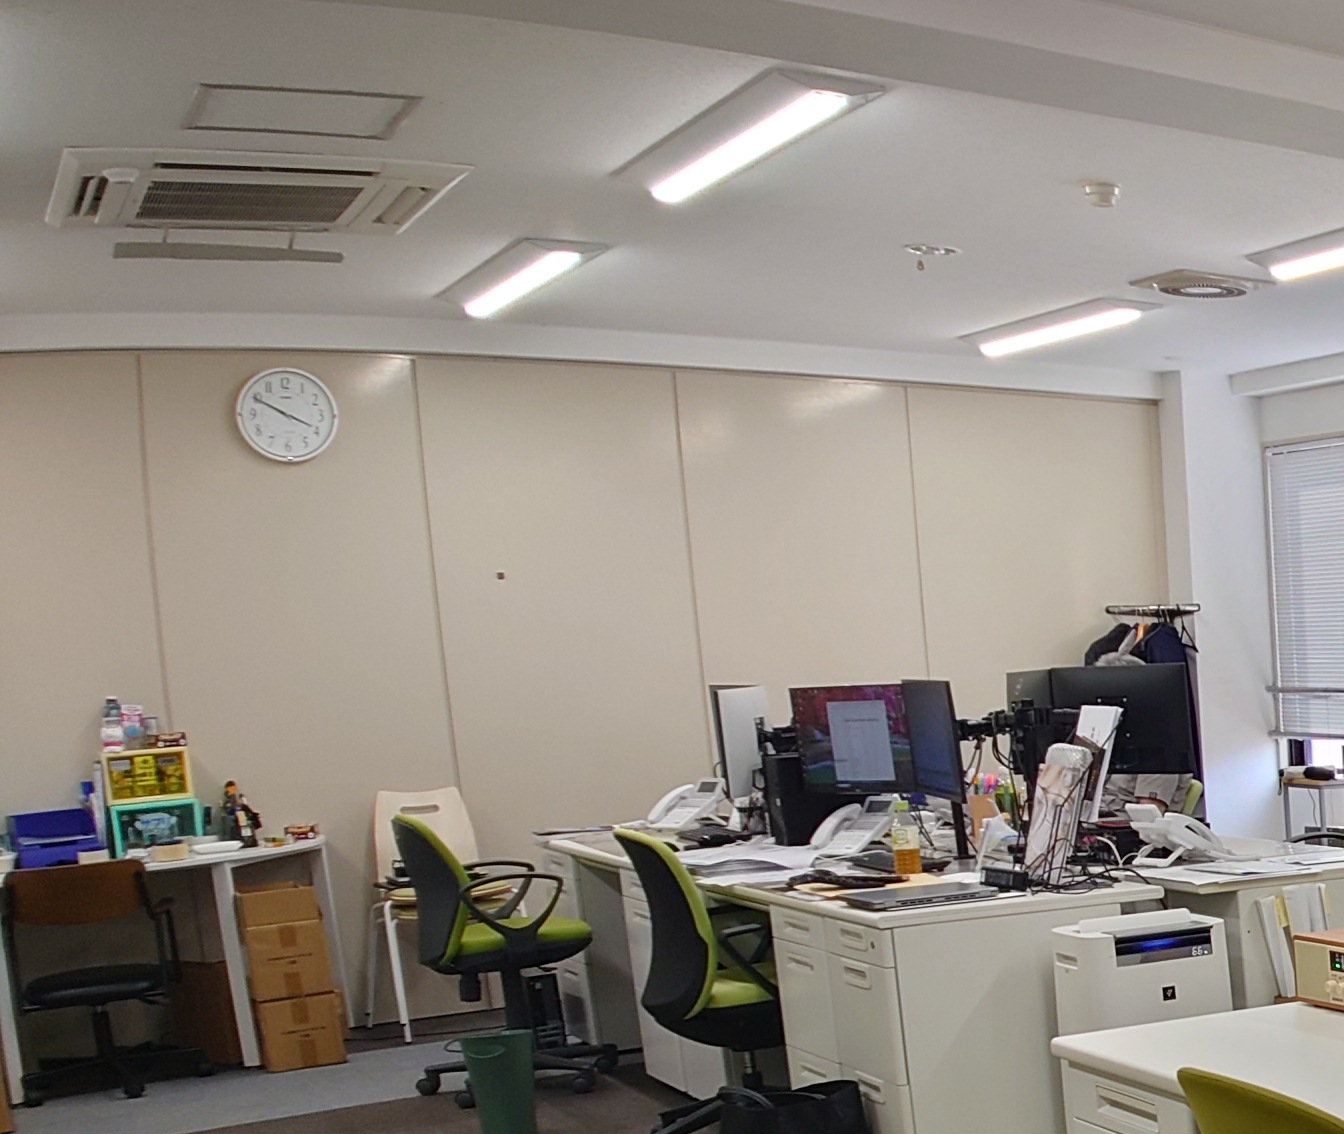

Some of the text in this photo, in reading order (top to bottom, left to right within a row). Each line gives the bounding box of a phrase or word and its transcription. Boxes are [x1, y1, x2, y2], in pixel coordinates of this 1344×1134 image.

[265, 381, 272, 393] 11
[280, 377, 291, 390] 12
[300, 383, 305, 394] 1
[312, 394, 319, 406] 2
[249, 407, 257, 421] 9
[317, 409, 325, 422] 3
[255, 424, 263, 437] 8
[285, 441, 292, 452] 6
[303, 436, 309, 449] 5
